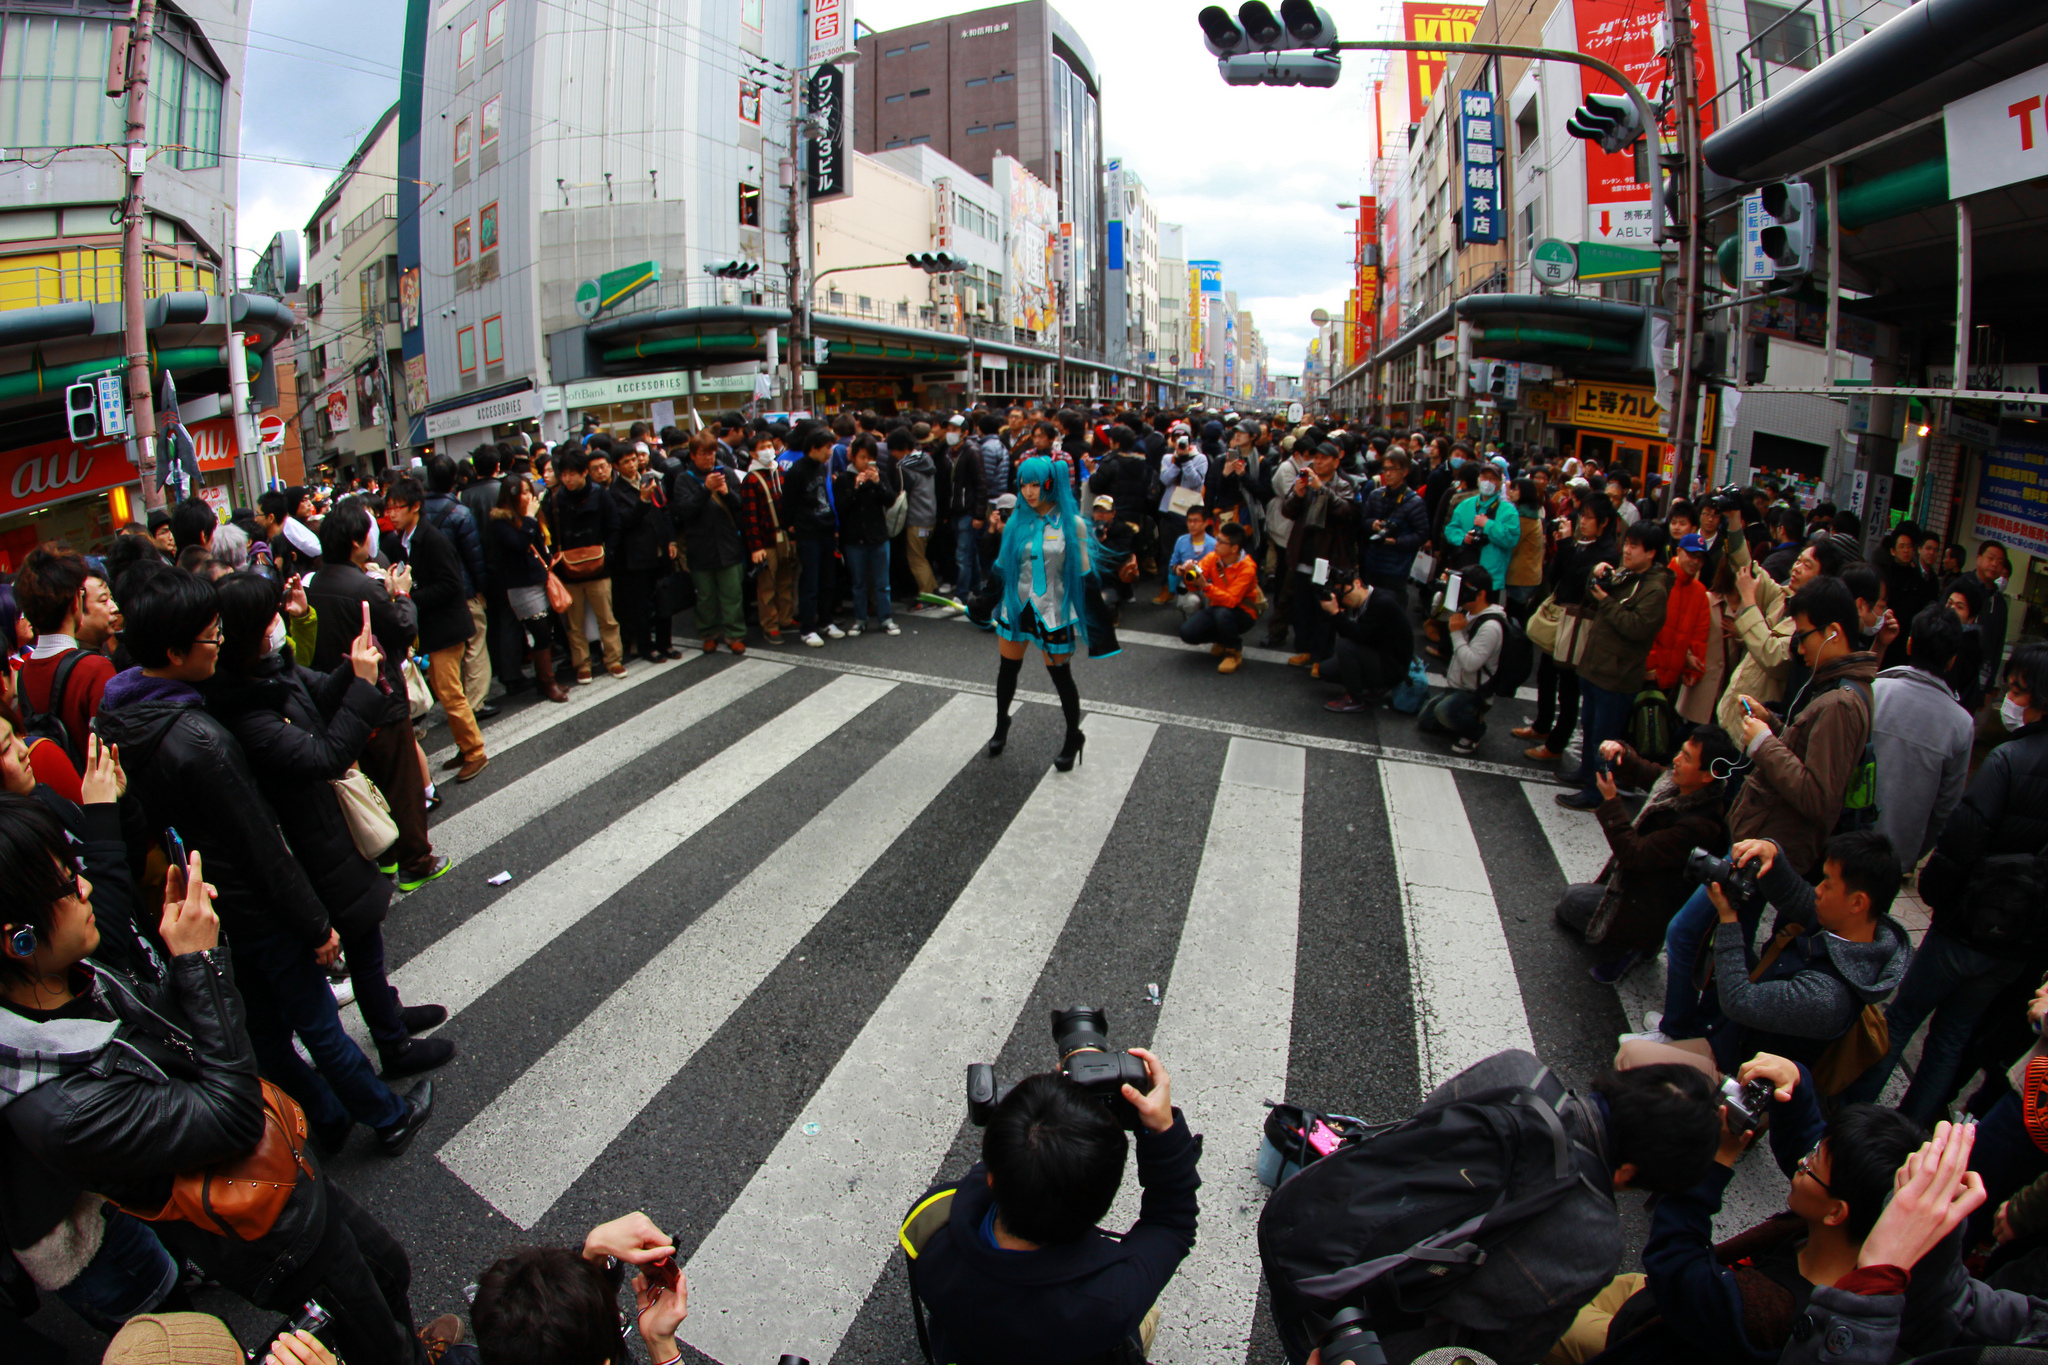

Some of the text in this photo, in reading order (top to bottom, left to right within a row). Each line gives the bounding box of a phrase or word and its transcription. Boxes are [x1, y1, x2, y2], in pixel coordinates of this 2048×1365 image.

[2008, 95, 2048, 151] T
[1546, 263, 1561, 278] 西
[617, 378, 681, 394] ACCESSORIES
[478, 400, 522, 421] ACCESSORIES
[193, 429, 231, 461] au
[11, 449, 94, 498] au
[1427, 1264, 1449, 1276] NIKE
